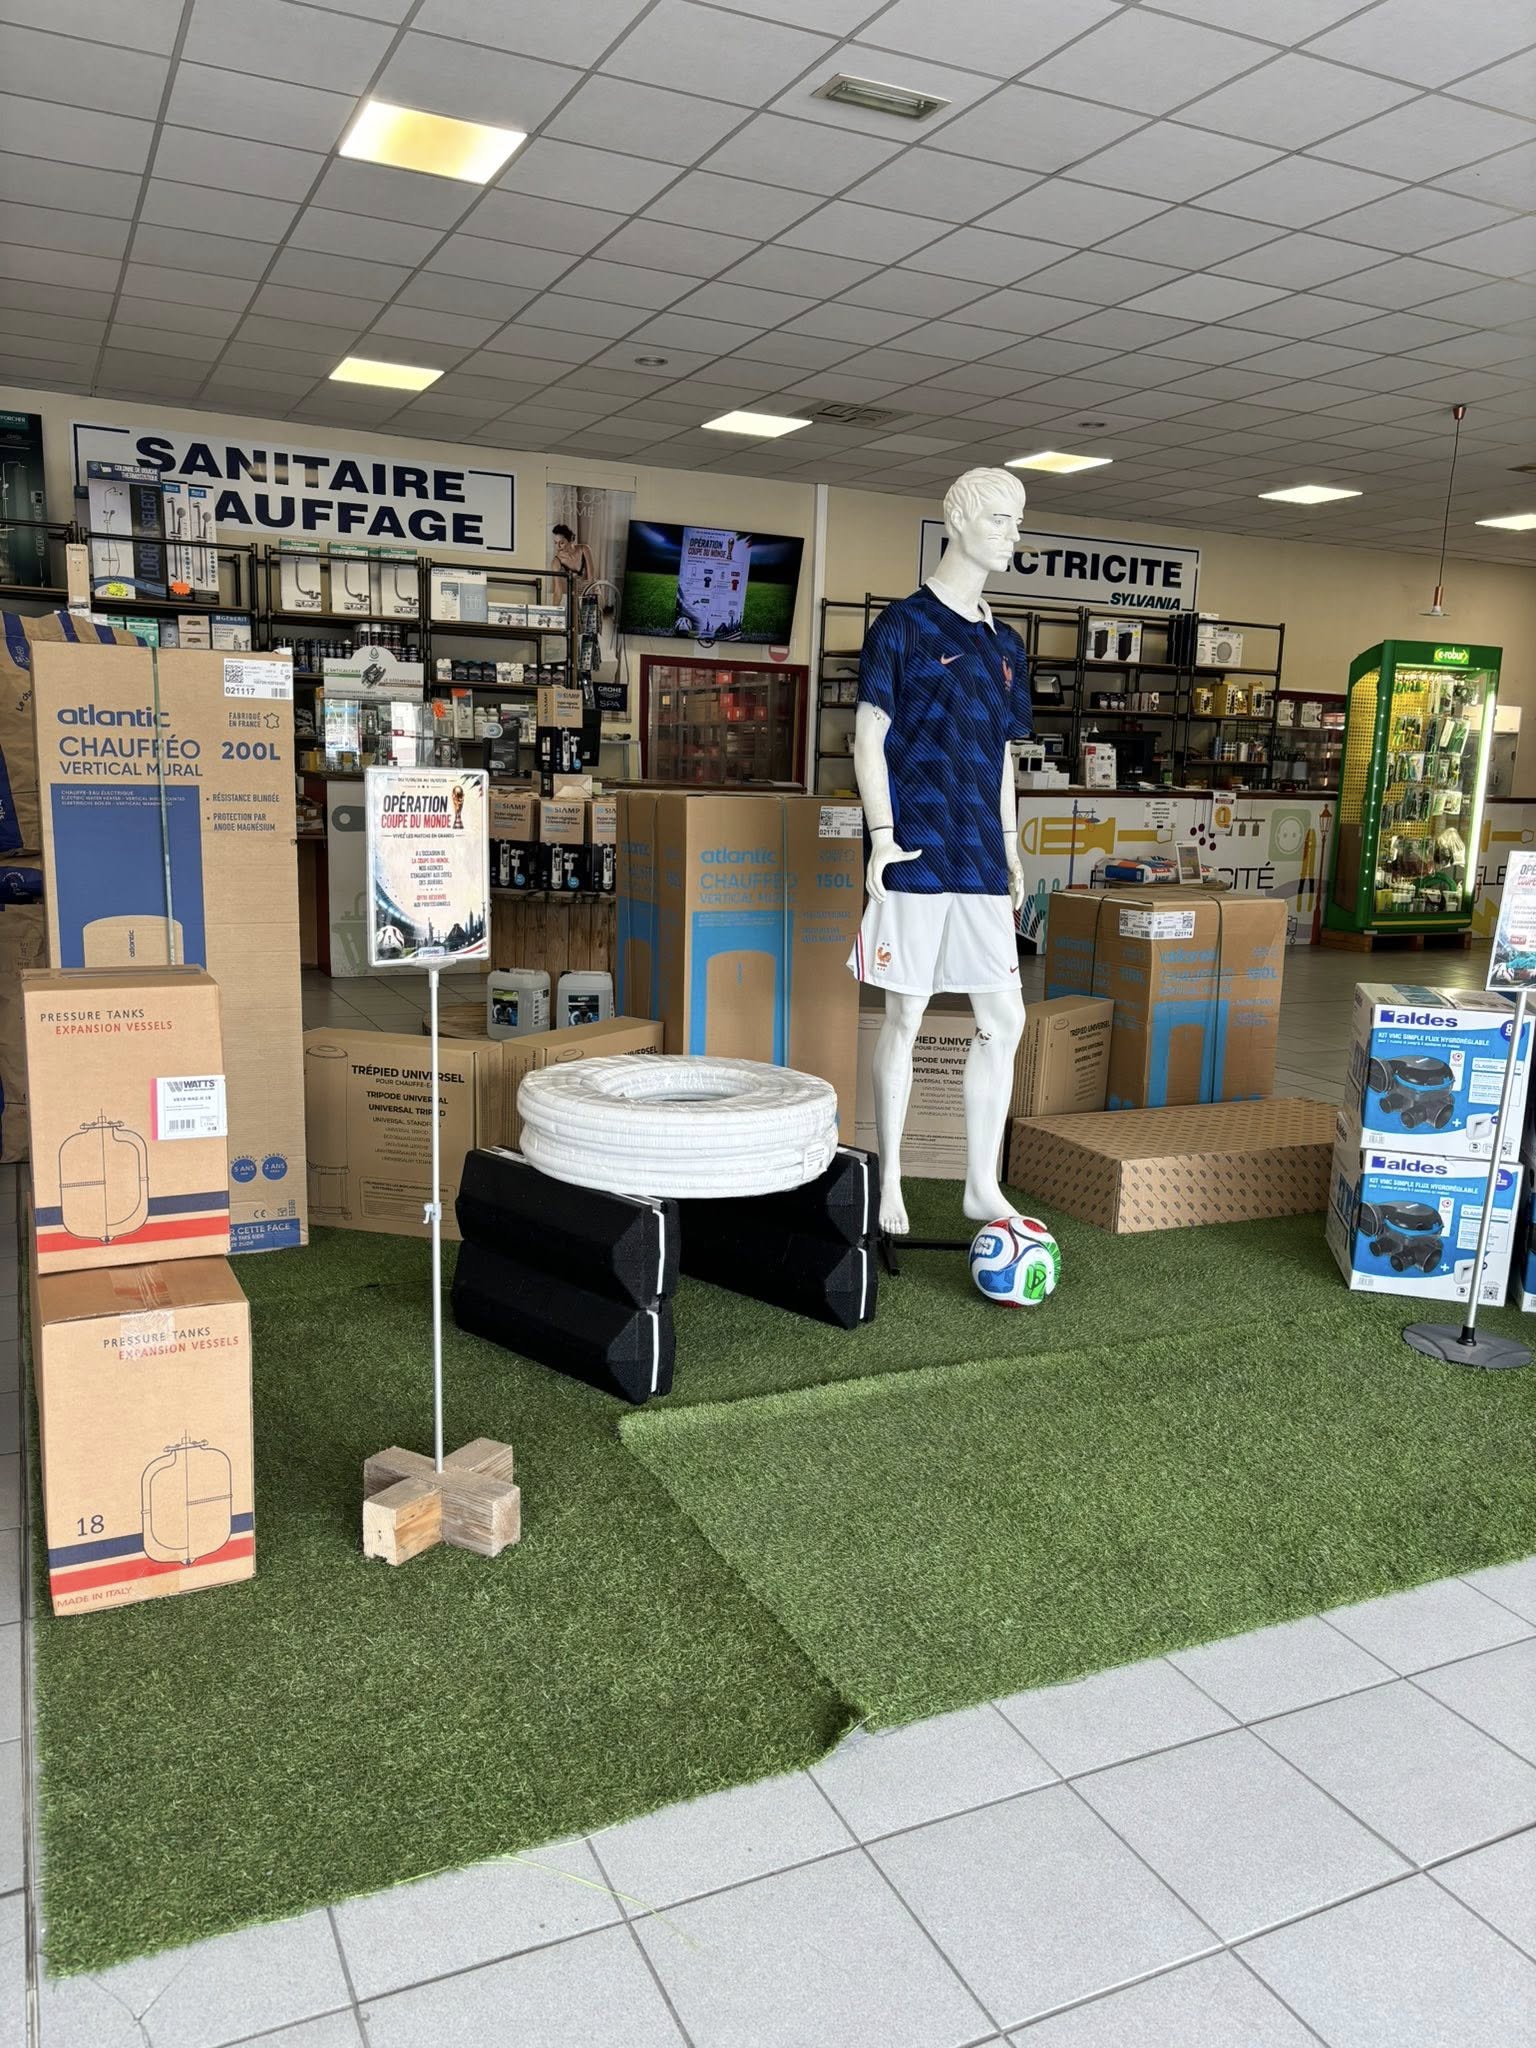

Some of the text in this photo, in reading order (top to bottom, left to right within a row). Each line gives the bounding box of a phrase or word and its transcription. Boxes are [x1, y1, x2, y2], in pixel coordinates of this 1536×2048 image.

[135, 437, 466, 502] SANITAIRE
[214, 489, 484, 545] AUFFAGE
[1110, 592, 1181, 611] SYLVANIA
[225, 686, 256, 695] 021117
[598, 686, 622, 694] GROHE
[57, 703, 171, 728] atlantic
[228, 711, 261, 720] FABRIQUÉ
[59, 734, 201, 759] CHAUFFÉO
[222, 741, 281, 760] 200L
[60, 761, 203, 777] VERTICAL MURAL
[212, 792, 280, 802] RÉSISTANCE BLINDÉE
[383, 791, 448, 813] OPÉRATION
[502, 803, 526, 811] SIAMP
[213, 812, 266, 821] PROTECTION PAR
[381, 814, 452, 829] COUPE DU MONDE
[214, 823, 275, 832] ANODE MAGNÉSIUM
[700, 847, 778, 865] atlantic
[815, 872, 855, 889] 150L
[700, 892, 752, 904] VERTICAL
[128, 929, 136, 958] atlantic
[40, 1009, 145, 1022] PRESSURE TANKS
[1396, 1012, 1458, 1028] aldes
[55, 1021, 173, 1035] EXPANSION VESSELS
[939, 1036, 972, 1047] UNIVE
[351, 1064, 465, 1083] TRÉPIED UNIVRSEL
[912, 1067, 949, 1075] NIVERSAL
[183, 1080, 215, 1088] WATTS
[366, 1090, 449, 1104] TRIPODE UNIVERAL
[368, 1104, 446, 1117] UNIVERSAL TRIPD
[373, 1117, 404, 1125] UNIVERSAL
[1387, 1159, 1447, 1175] aldes
[1380, 1178, 1392, 1186] VMC
[1394, 1179, 1414, 1187] SIMPLE
[237, 1223, 290, 1235] CETTE FACE
[103, 1326, 211, 1349] PRESSURE TANKS
[191, 1336, 239, 1350] VESSELS
[77, 1514, 105, 1537] 18
[57, 1586, 132, 1608] MADE IN ITALY
